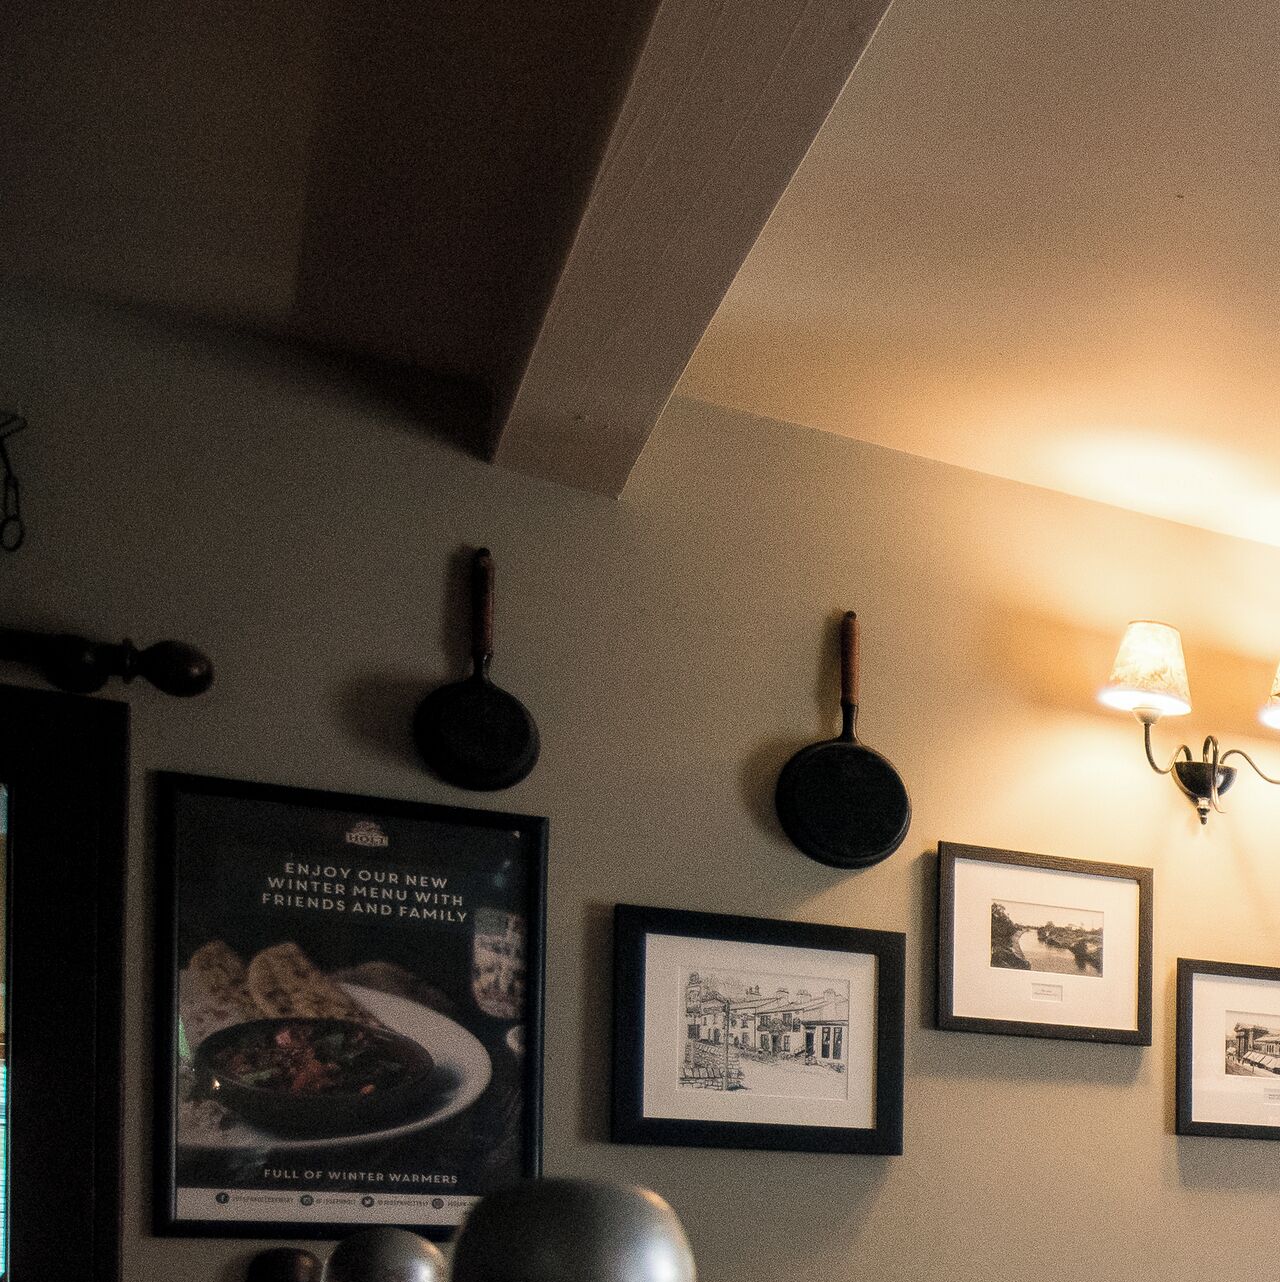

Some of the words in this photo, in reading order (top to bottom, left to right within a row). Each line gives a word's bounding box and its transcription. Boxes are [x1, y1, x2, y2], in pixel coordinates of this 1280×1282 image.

[284, 862, 351, 879] ENJOY
[358, 870, 399, 884] OUR
[406, 874, 448, 889] NEW
[267, 876, 346, 896] WINTER
[352, 885, 408, 901] MENU
[415, 891, 464, 907] WITH
[261, 892, 346, 912] FRIENDS
[352, 902, 393, 916] AND
[399, 906, 468, 923] FAMILY
[263, 1168, 299, 1180] FULL
[304, 1169, 324, 1180] OF
[328, 1170, 385, 1182] WINTER
[388, 1172, 459, 1184] WARMERS
